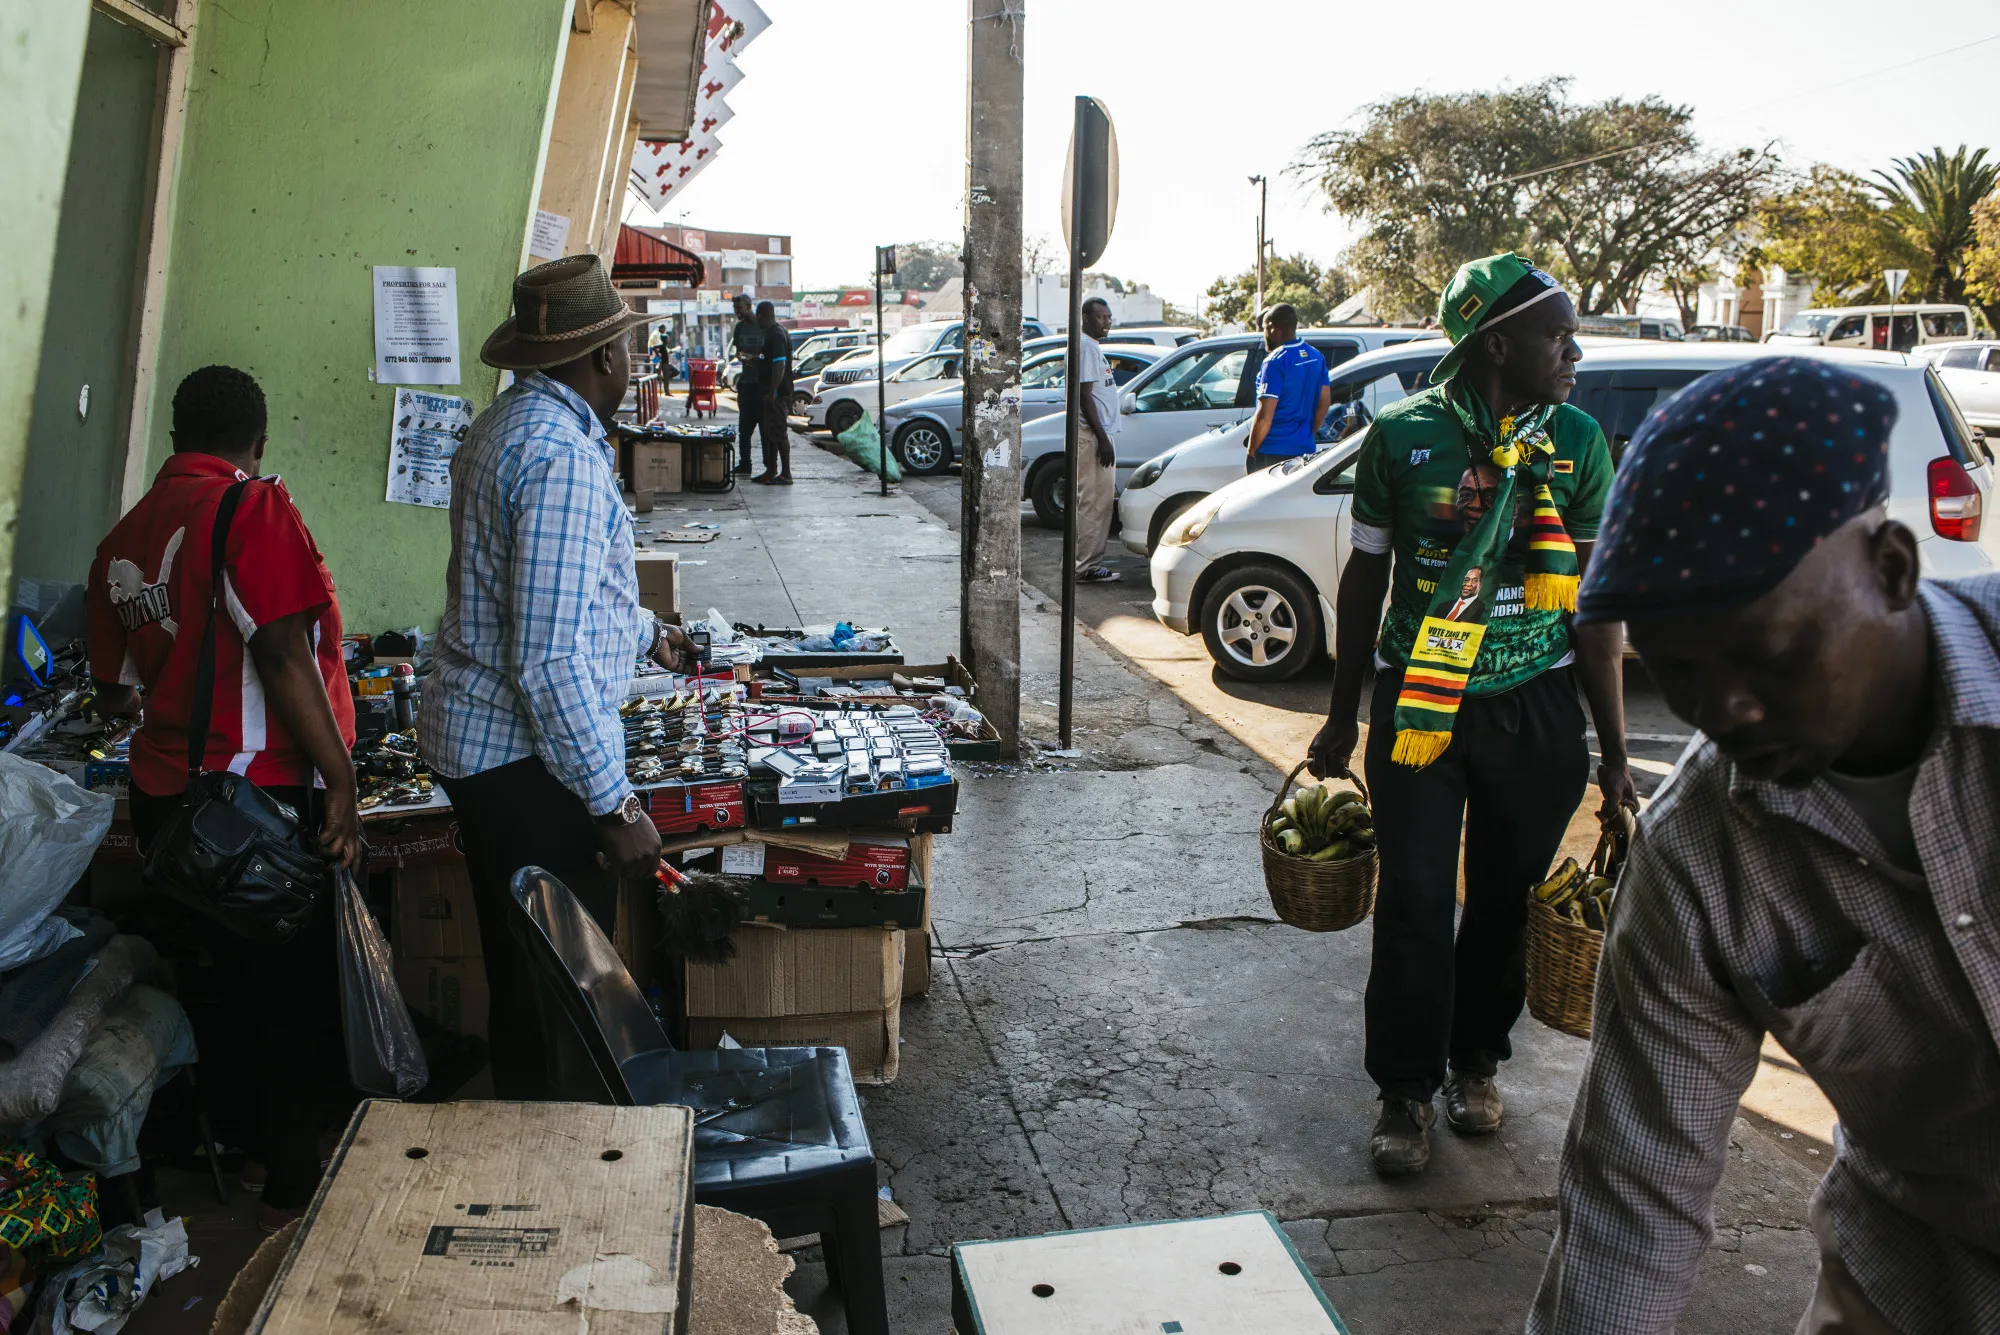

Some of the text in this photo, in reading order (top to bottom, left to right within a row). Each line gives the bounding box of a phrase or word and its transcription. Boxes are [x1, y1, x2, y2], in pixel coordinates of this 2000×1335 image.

[382, 280, 418, 288] PROPERTIES
[384, 355, 397, 363] 0772
[1430, 558, 1447, 567] PEOP
[1417, 578, 1437, 594] VOT
[1495, 586, 1525, 601] NANG
[1428, 626, 1446, 637] VOTE
[1461, 631, 1471, 640] PF
